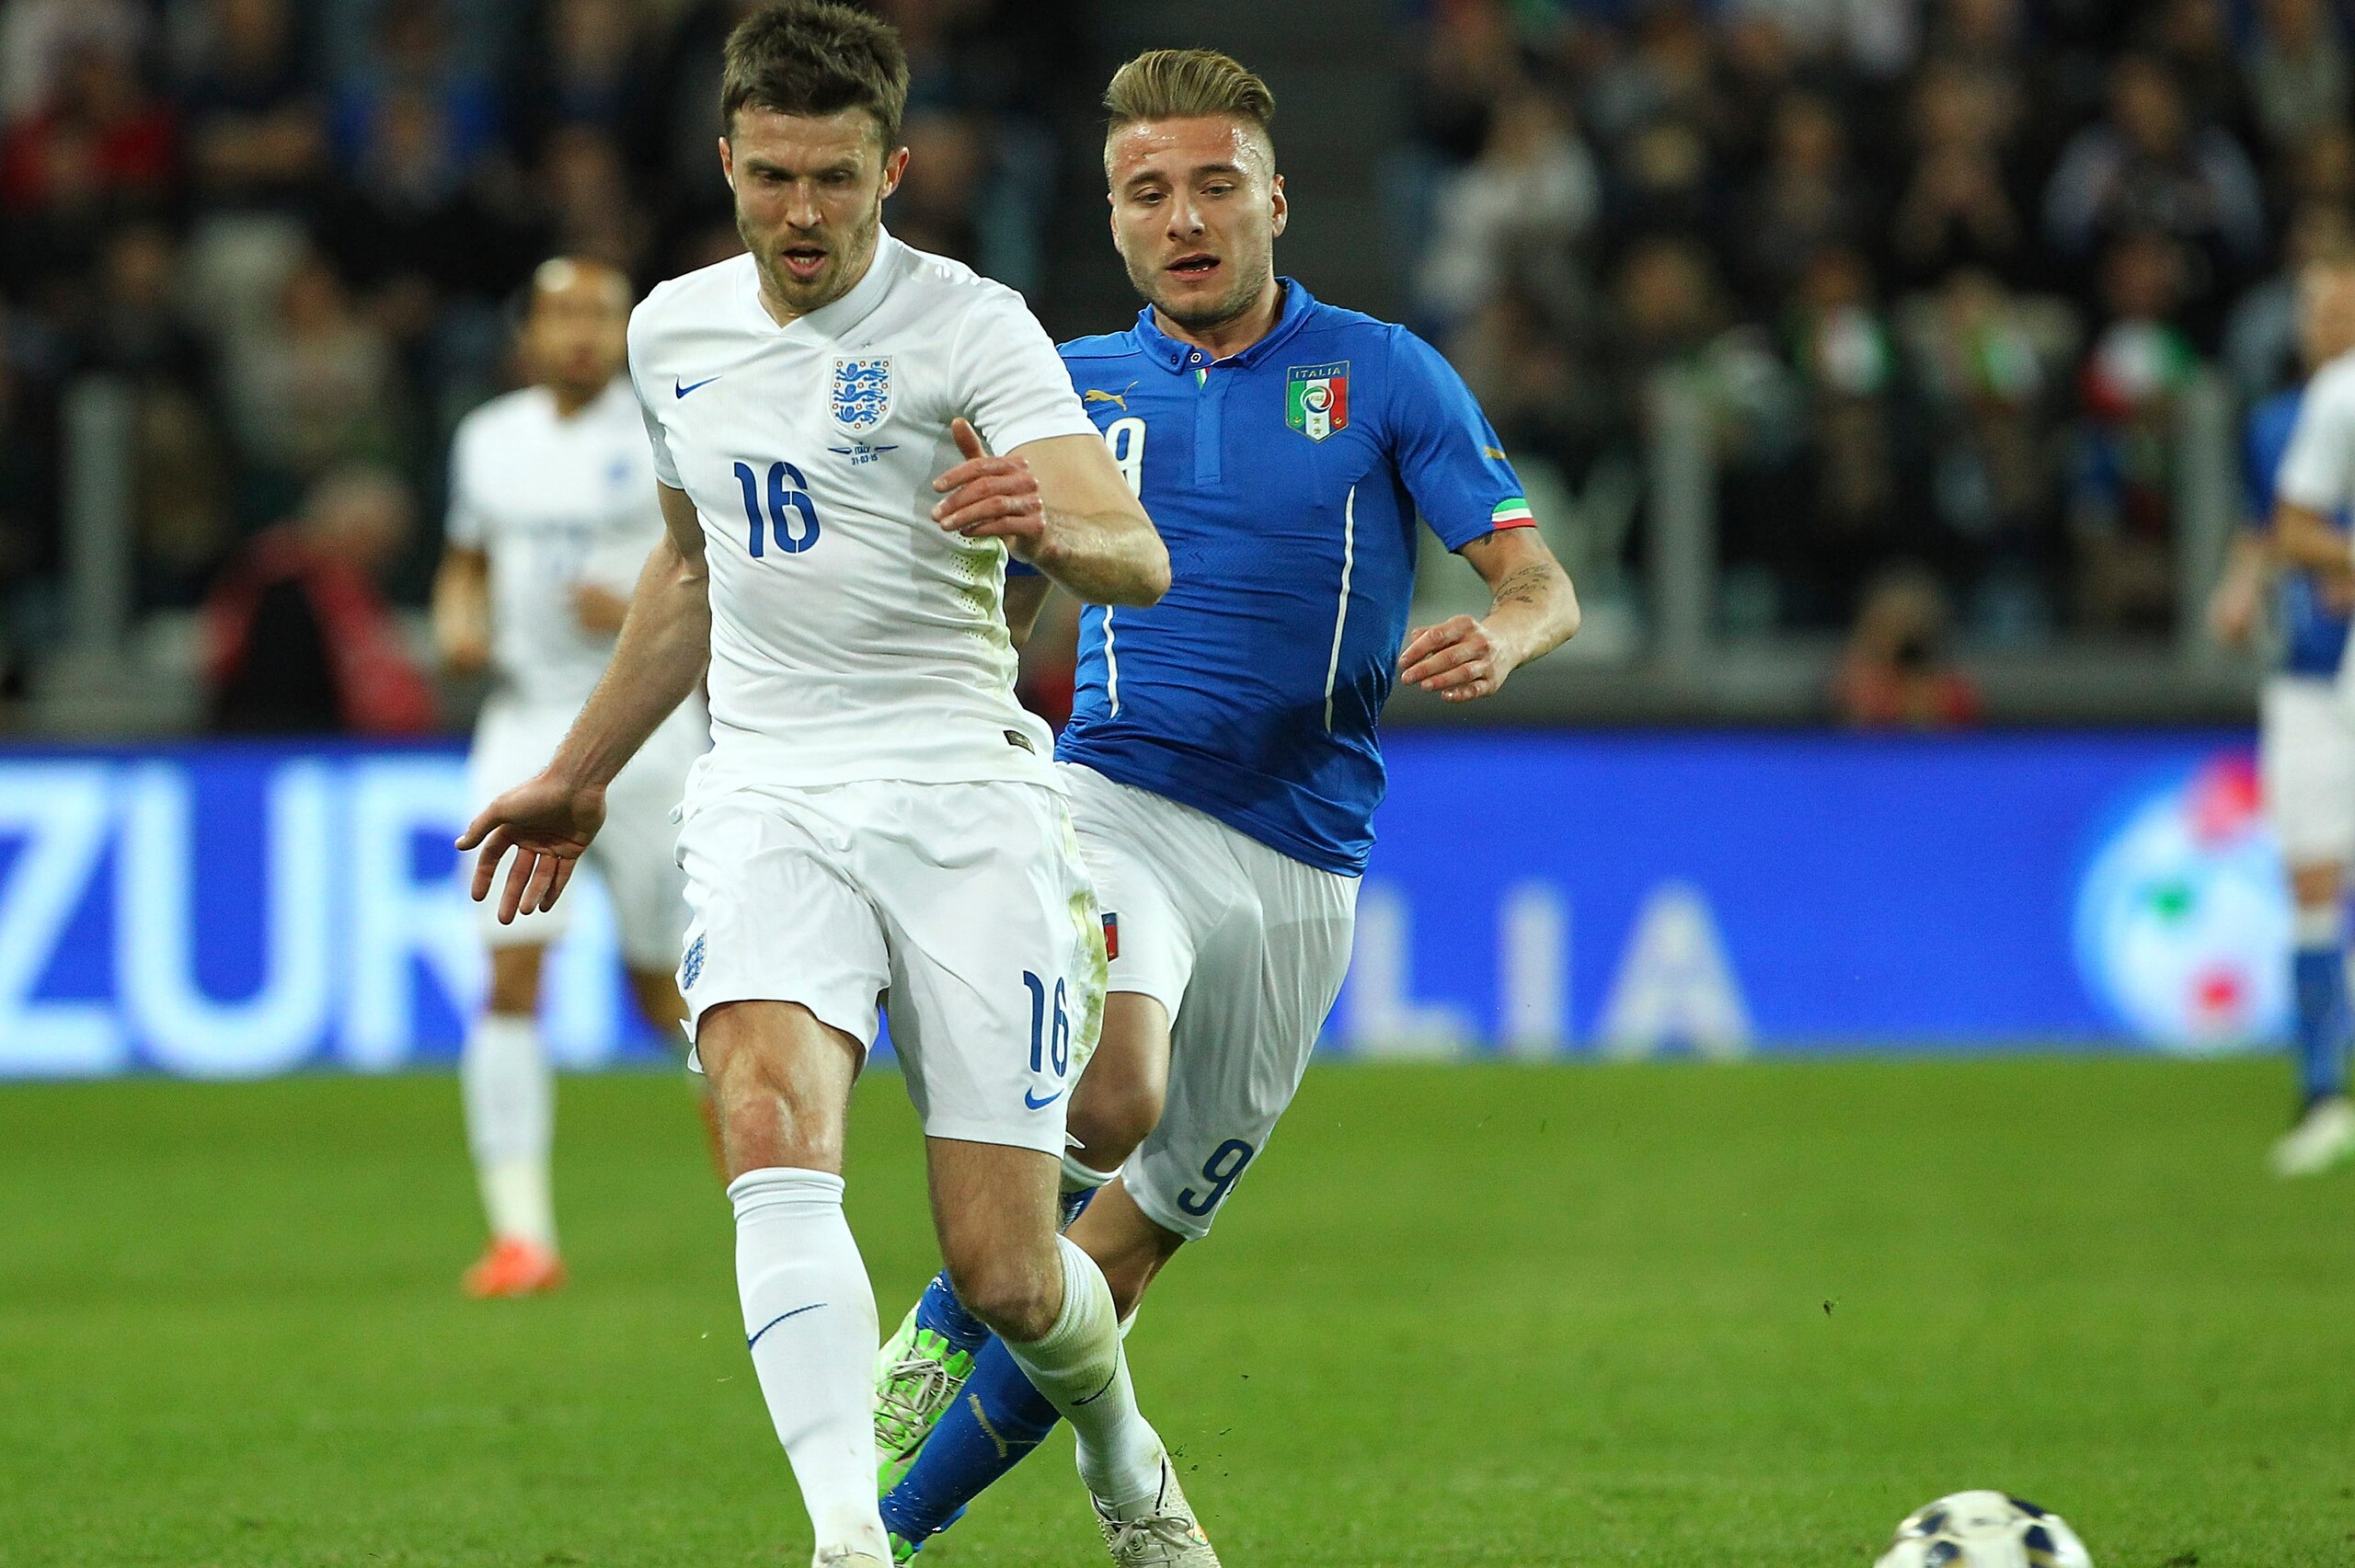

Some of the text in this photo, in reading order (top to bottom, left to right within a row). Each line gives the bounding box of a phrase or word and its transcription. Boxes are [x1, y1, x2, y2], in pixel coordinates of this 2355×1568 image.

[1295, 367, 1341, 379] ITALIA
[854, 445, 871, 455] ITALY
[733, 461, 821, 558] 16
[1023, 969, 1069, 1078] 16
[1177, 1139, 1255, 1217] 9
